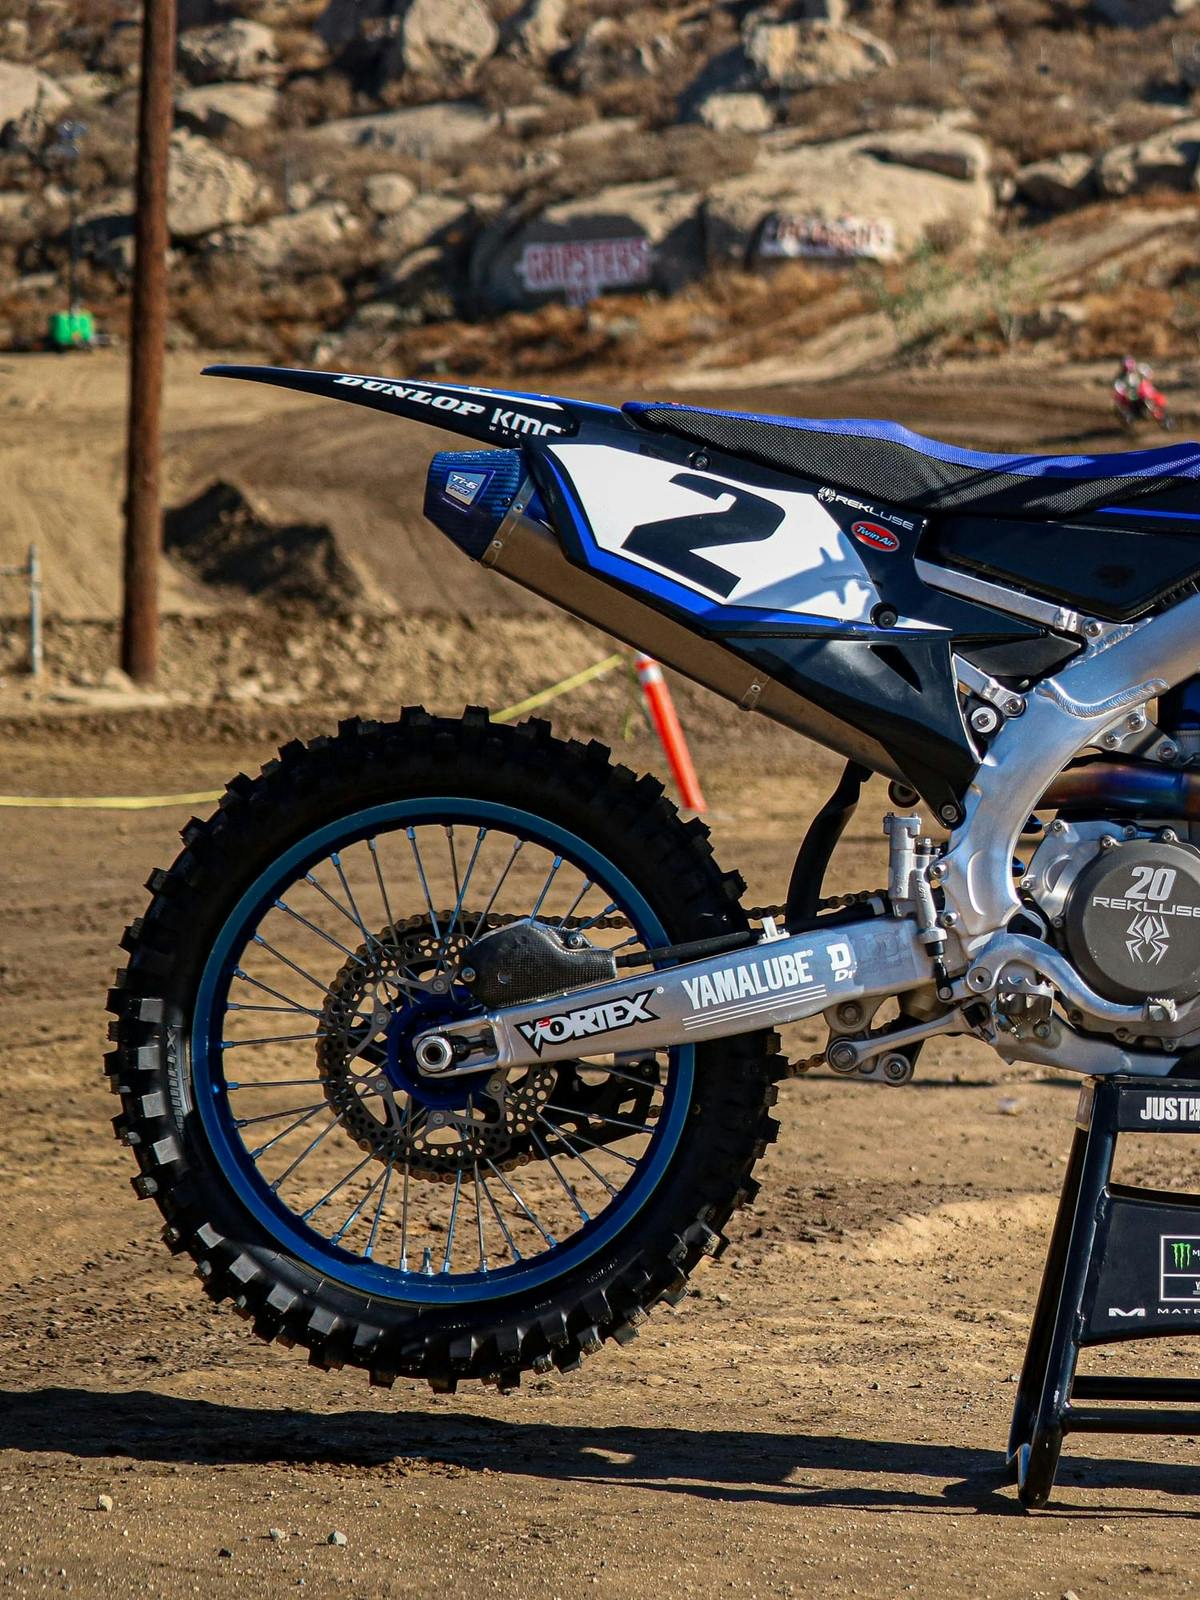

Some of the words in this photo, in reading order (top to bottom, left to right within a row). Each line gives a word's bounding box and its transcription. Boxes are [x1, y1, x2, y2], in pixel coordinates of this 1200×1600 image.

[333, 376, 486, 416] DUNLOP
[835, 494, 915, 531] REKLUSE
[620, 472, 787, 599] 2
[856, 525, 881, 541] Twin
[880, 536, 896, 547] Air
[1123, 866, 1177, 901] 20
[681, 952, 813, 1011] YAMALUBE
[519, 991, 656, 1050] VORTEX
